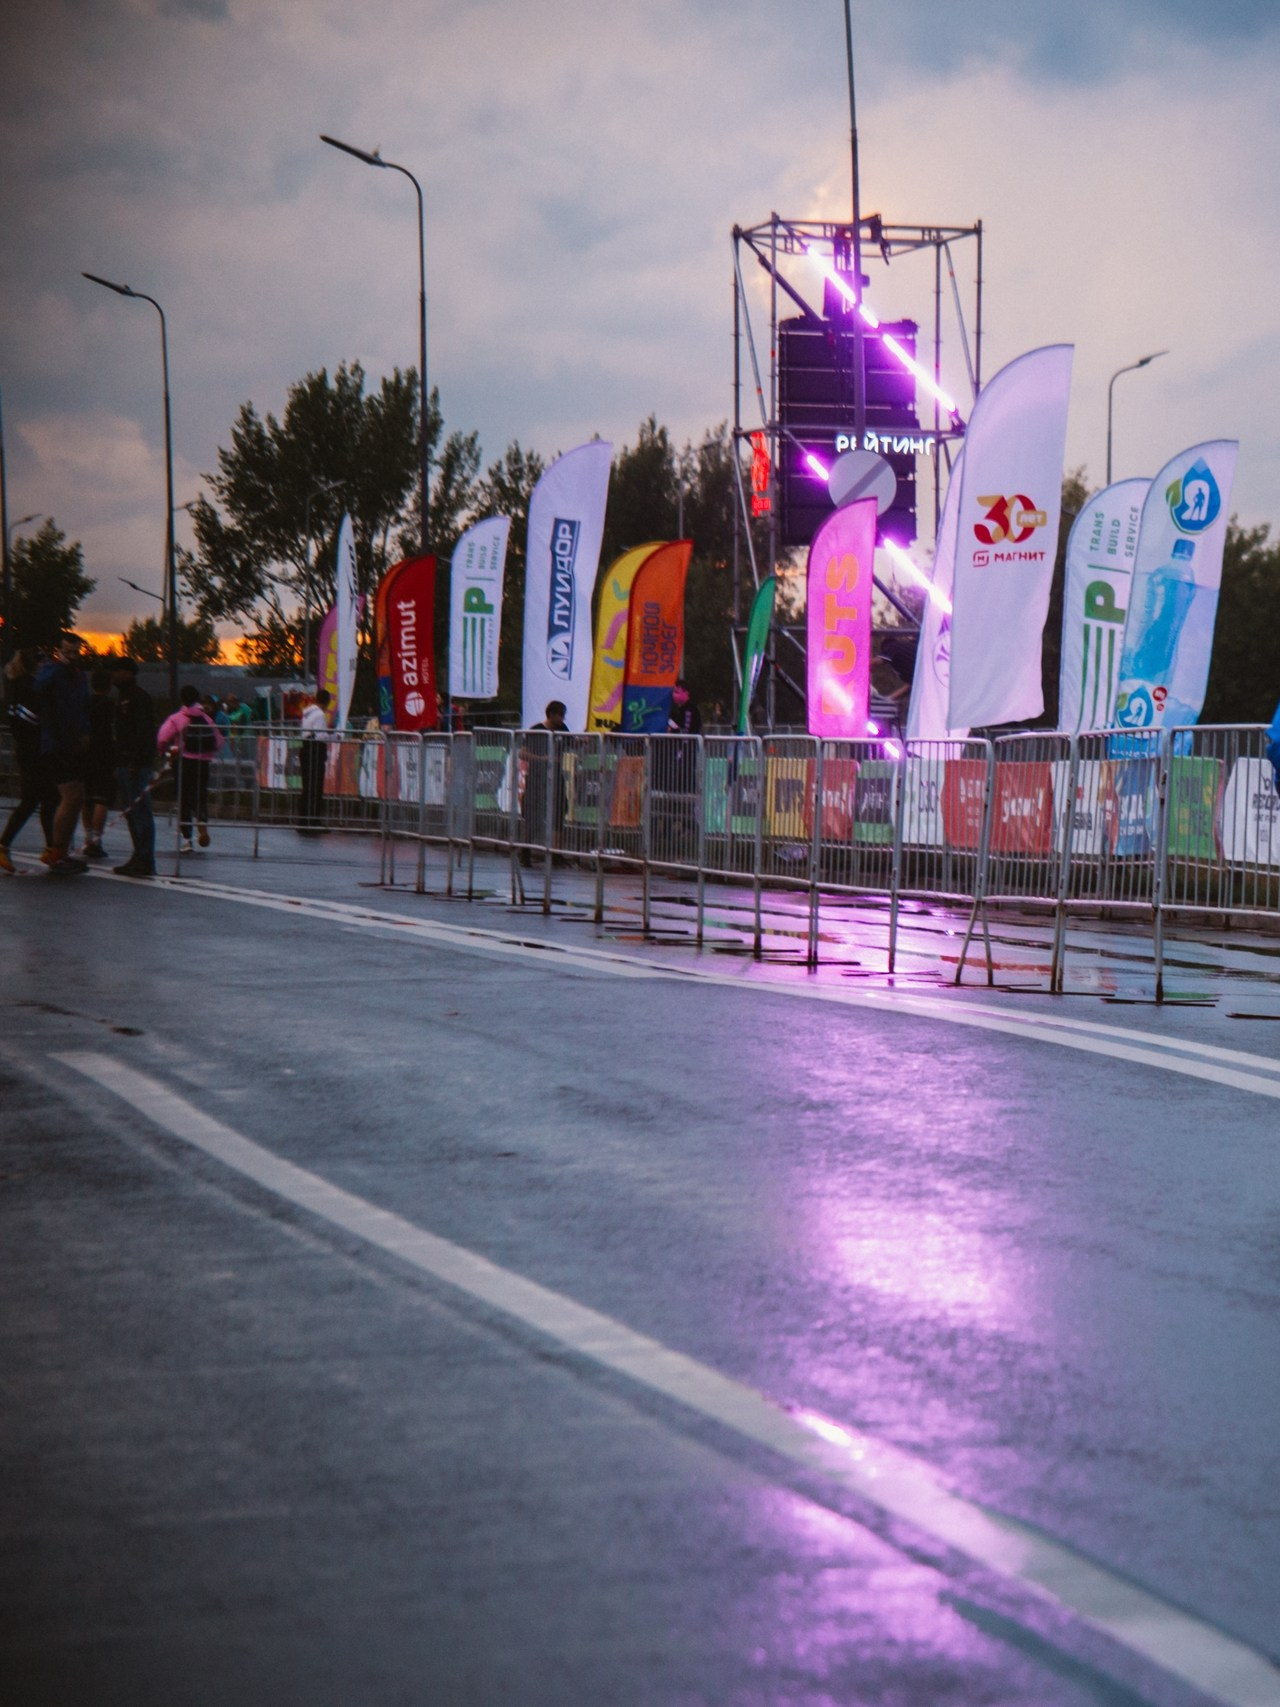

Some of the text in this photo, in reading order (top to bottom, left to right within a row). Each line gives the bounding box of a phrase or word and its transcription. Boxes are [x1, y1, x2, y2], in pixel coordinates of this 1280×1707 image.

[974, 494, 1037, 545] 30
[1089, 512, 1105, 552] TRANS
[1107, 519, 1122, 555] BUILD
[1125, 506, 1140, 558] SERVICE
[554, 523, 573, 629] ЛУИДОР
[994, 551, 1046, 563] МАГНИТ
[397, 599, 419, 687] azimut
